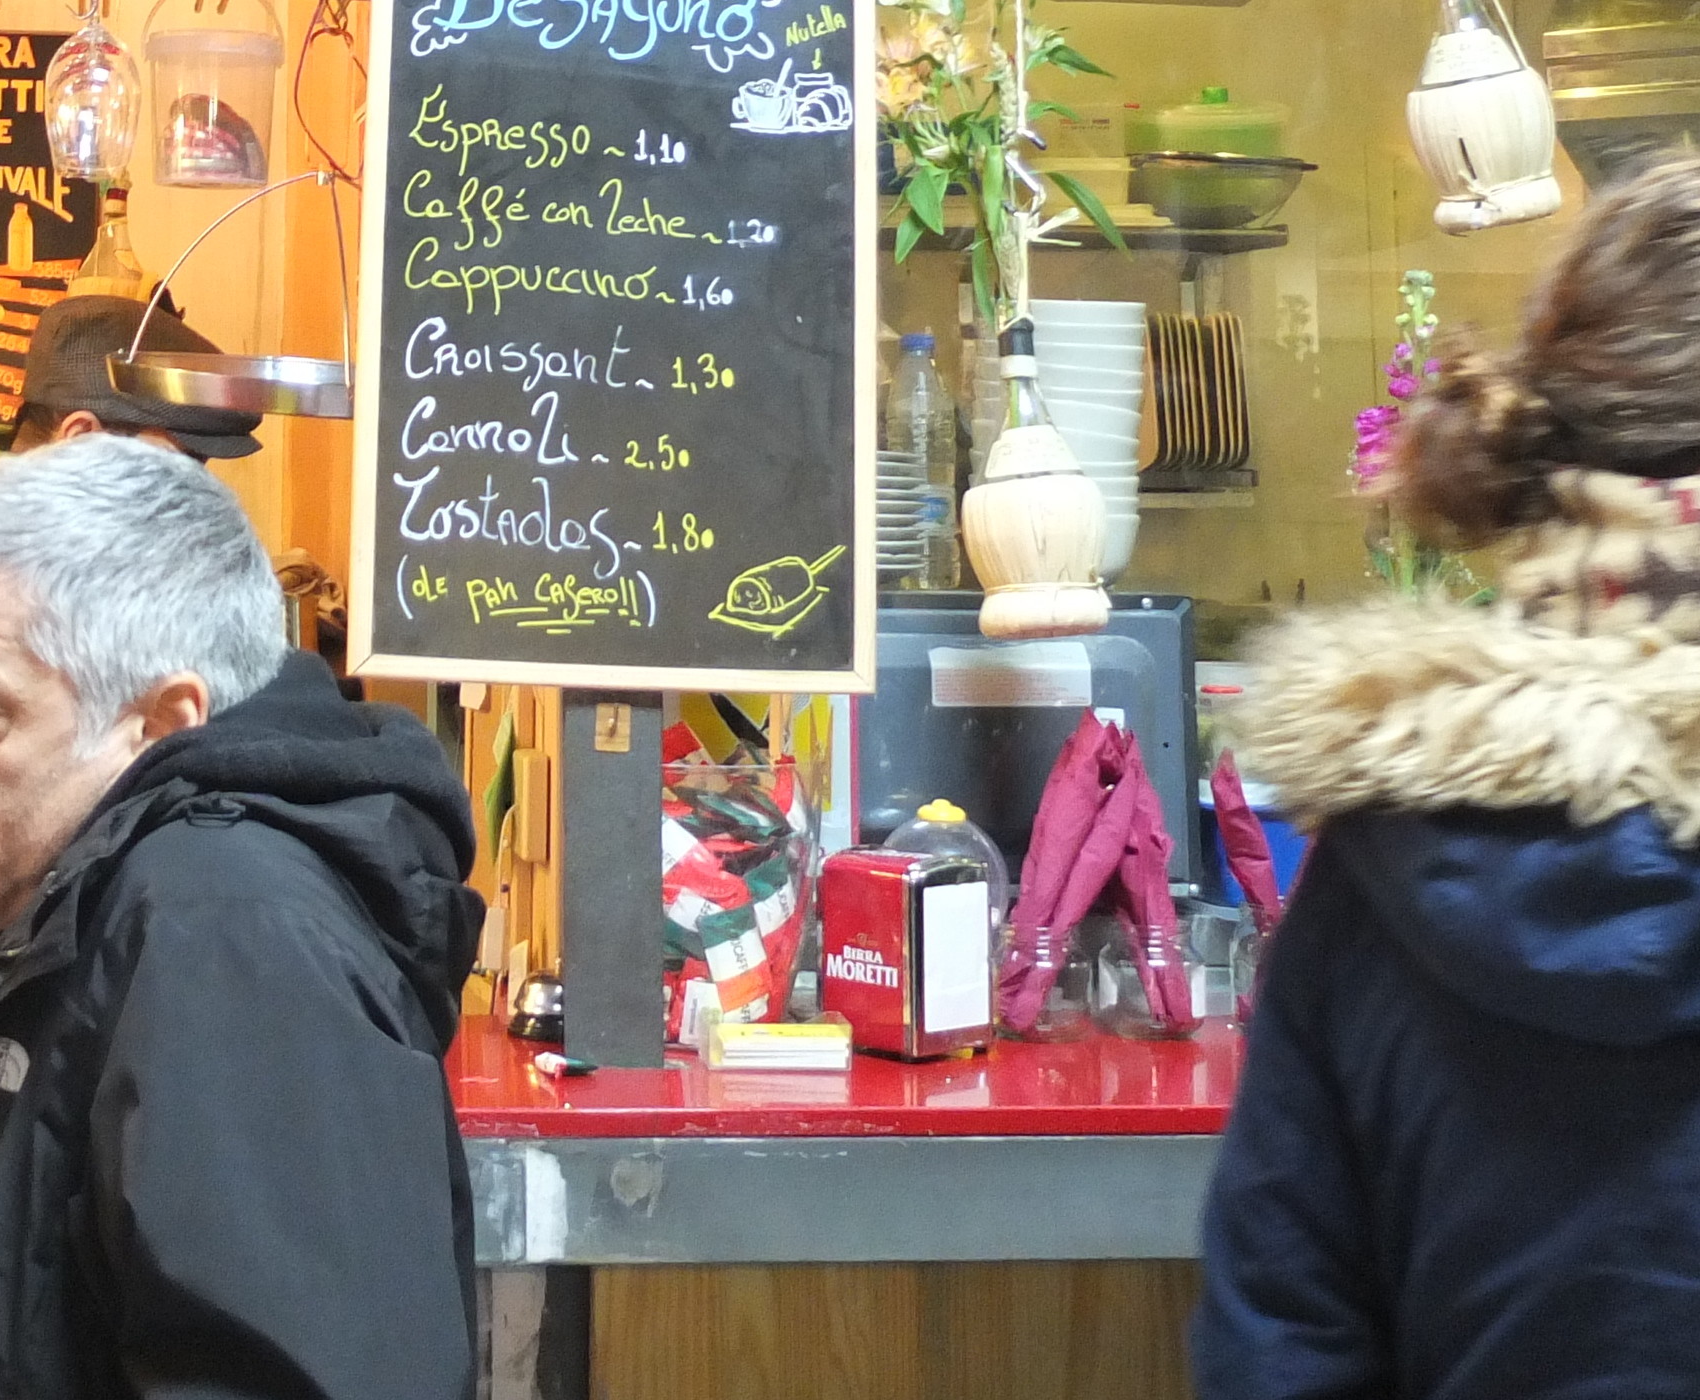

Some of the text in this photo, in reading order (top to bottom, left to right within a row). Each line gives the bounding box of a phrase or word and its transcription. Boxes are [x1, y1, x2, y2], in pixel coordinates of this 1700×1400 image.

[542, 202, 593, 228] con
[682, 274, 734, 311] 1,60
[671, 353, 735, 394] 1,30
[652, 510, 714, 554] 1,80
[826, 953, 899, 988] MORETTI
[843, 945, 884, 965] BIRRA
